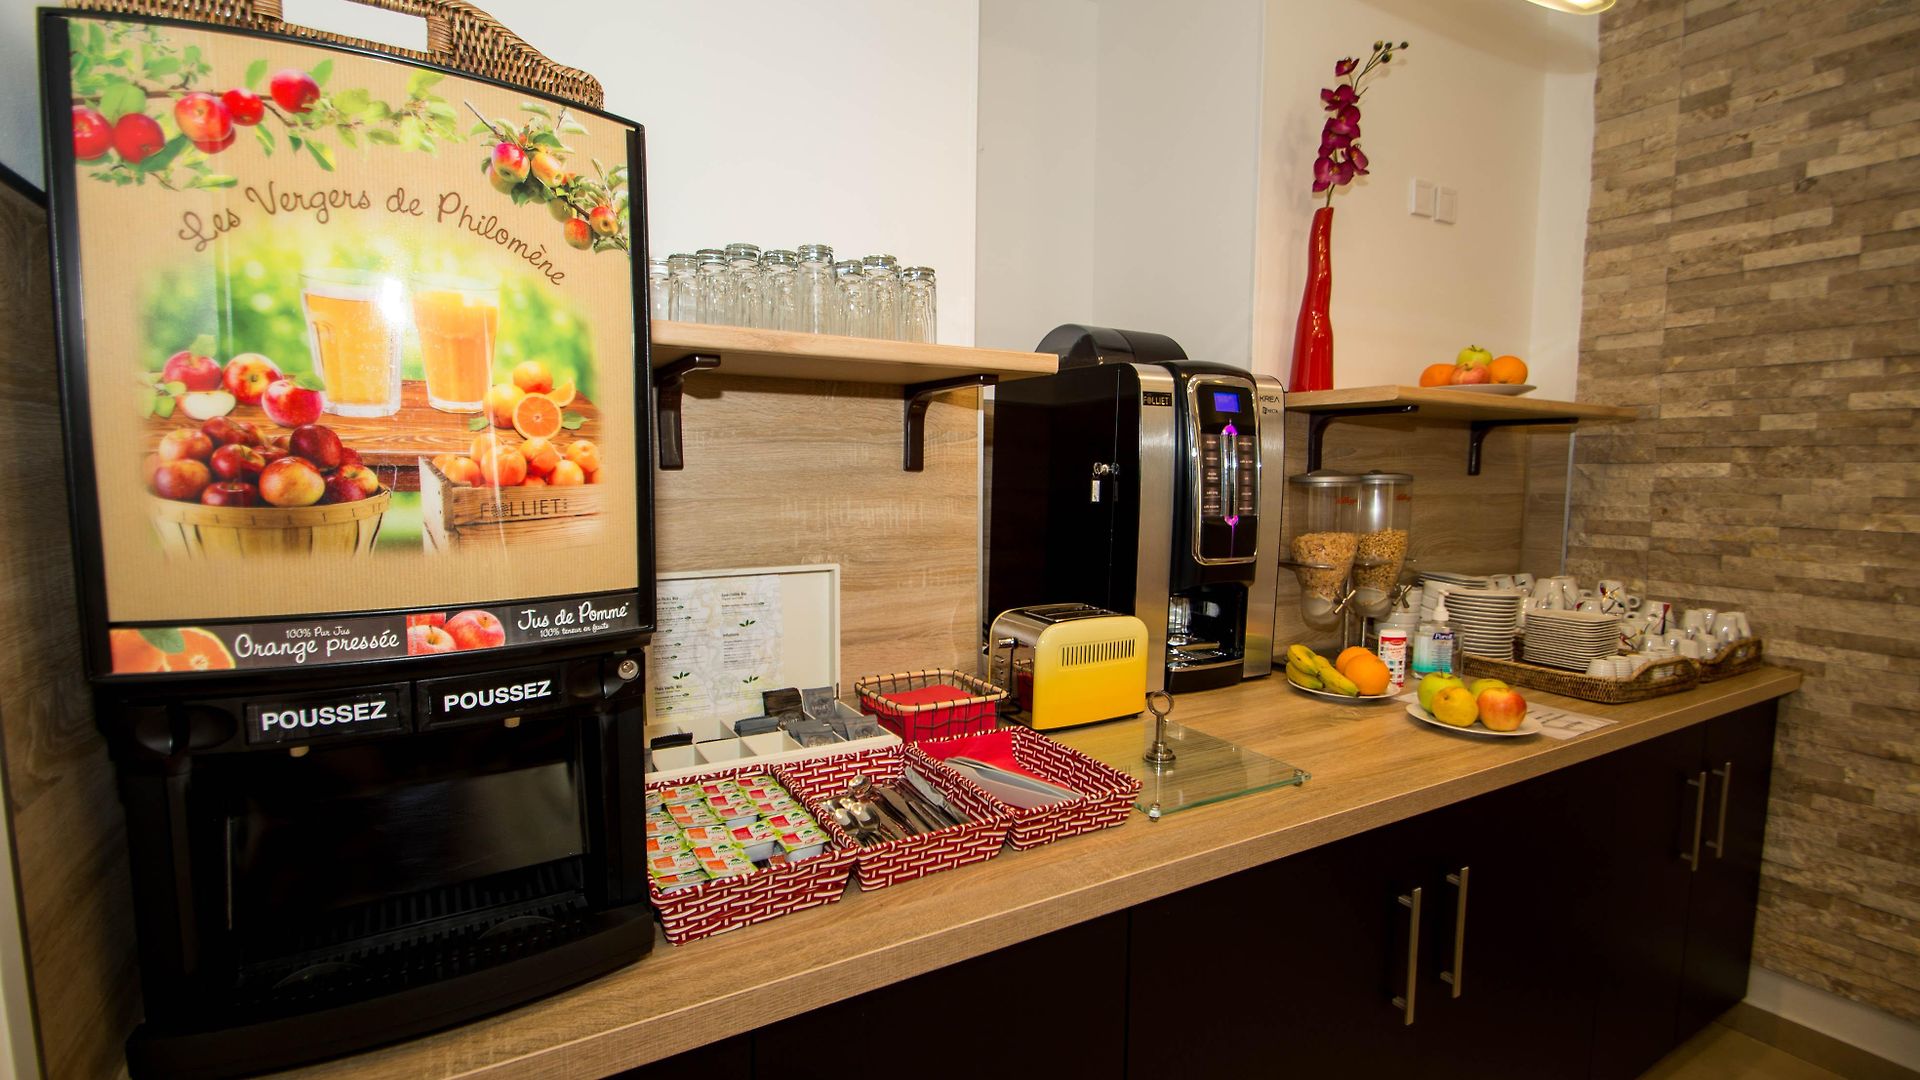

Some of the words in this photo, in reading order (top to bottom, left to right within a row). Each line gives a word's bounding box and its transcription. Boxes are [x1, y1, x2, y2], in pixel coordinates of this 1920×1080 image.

[178, 208, 241, 252] Les
[245, 181, 371, 225] Vergers
[385, 187, 424, 217] de
[436, 191, 566, 286] Philomène
[480, 498, 561, 519] FOLLIET
[285, 628, 311, 639] 100%
[314, 627, 331, 637] Pur
[333, 626, 351, 636] Jus
[517, 609, 550, 630] Jus
[554, 609, 575, 626] de
[540, 627, 560, 638] 100%
[234, 633, 319, 663] Orange
[326, 629, 400, 657] pressée
[443, 679, 552, 713] POUSSEZ
[261, 700, 388, 732] POUSSEZ
